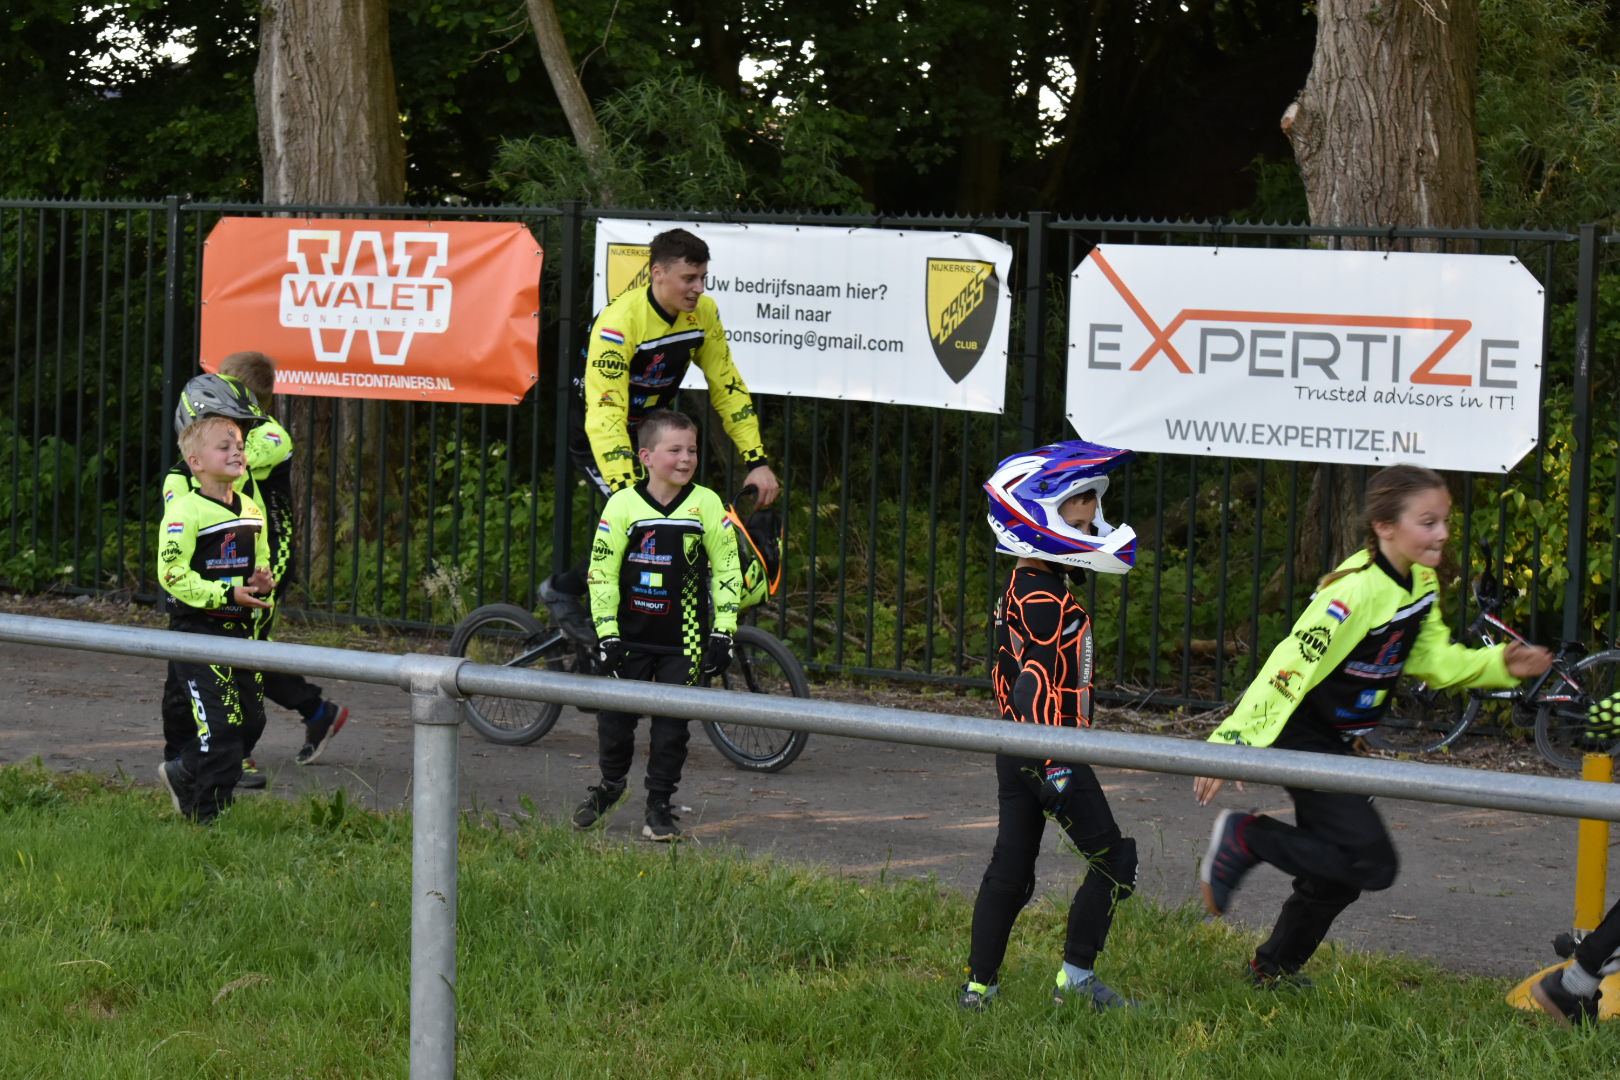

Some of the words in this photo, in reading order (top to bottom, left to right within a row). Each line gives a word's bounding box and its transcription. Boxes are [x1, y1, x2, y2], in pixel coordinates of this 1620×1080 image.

[931, 263, 976, 273] NIJKERKSE
[289, 280, 444, 312] WALET
[704, 275, 730, 292] Uw
[735, 276, 841, 299] bedrijfsnaam
[846, 282, 888, 301] hier?
[756, 302, 790, 321] Mail
[795, 308, 832, 323] naar
[939, 267, 984, 345] CROSS
[286, 313, 442, 328] CONTAINERS
[724, 329, 904, 353] ponsoring@gmail.com
[954, 340, 978, 350] CLUB
[1088, 306, 1520, 389] EXPERTIZE
[274, 369, 456, 391] WWW.WALETCONTAINERS.NL
[1294, 385, 1367, 403] Trusted
[1373, 386, 1454, 409] advisors
[1459, 388, 1483, 408] in
[1488, 394, 1515, 411] IT!
[1165, 418, 1426, 455] WWW.EXPERTIZE.NL
[1063, 556, 1092, 565] JOPA
[633, 599, 646, 607] VAN
[645, 601, 664, 609] HOUT
[1082, 663, 1091, 684] FIRST
